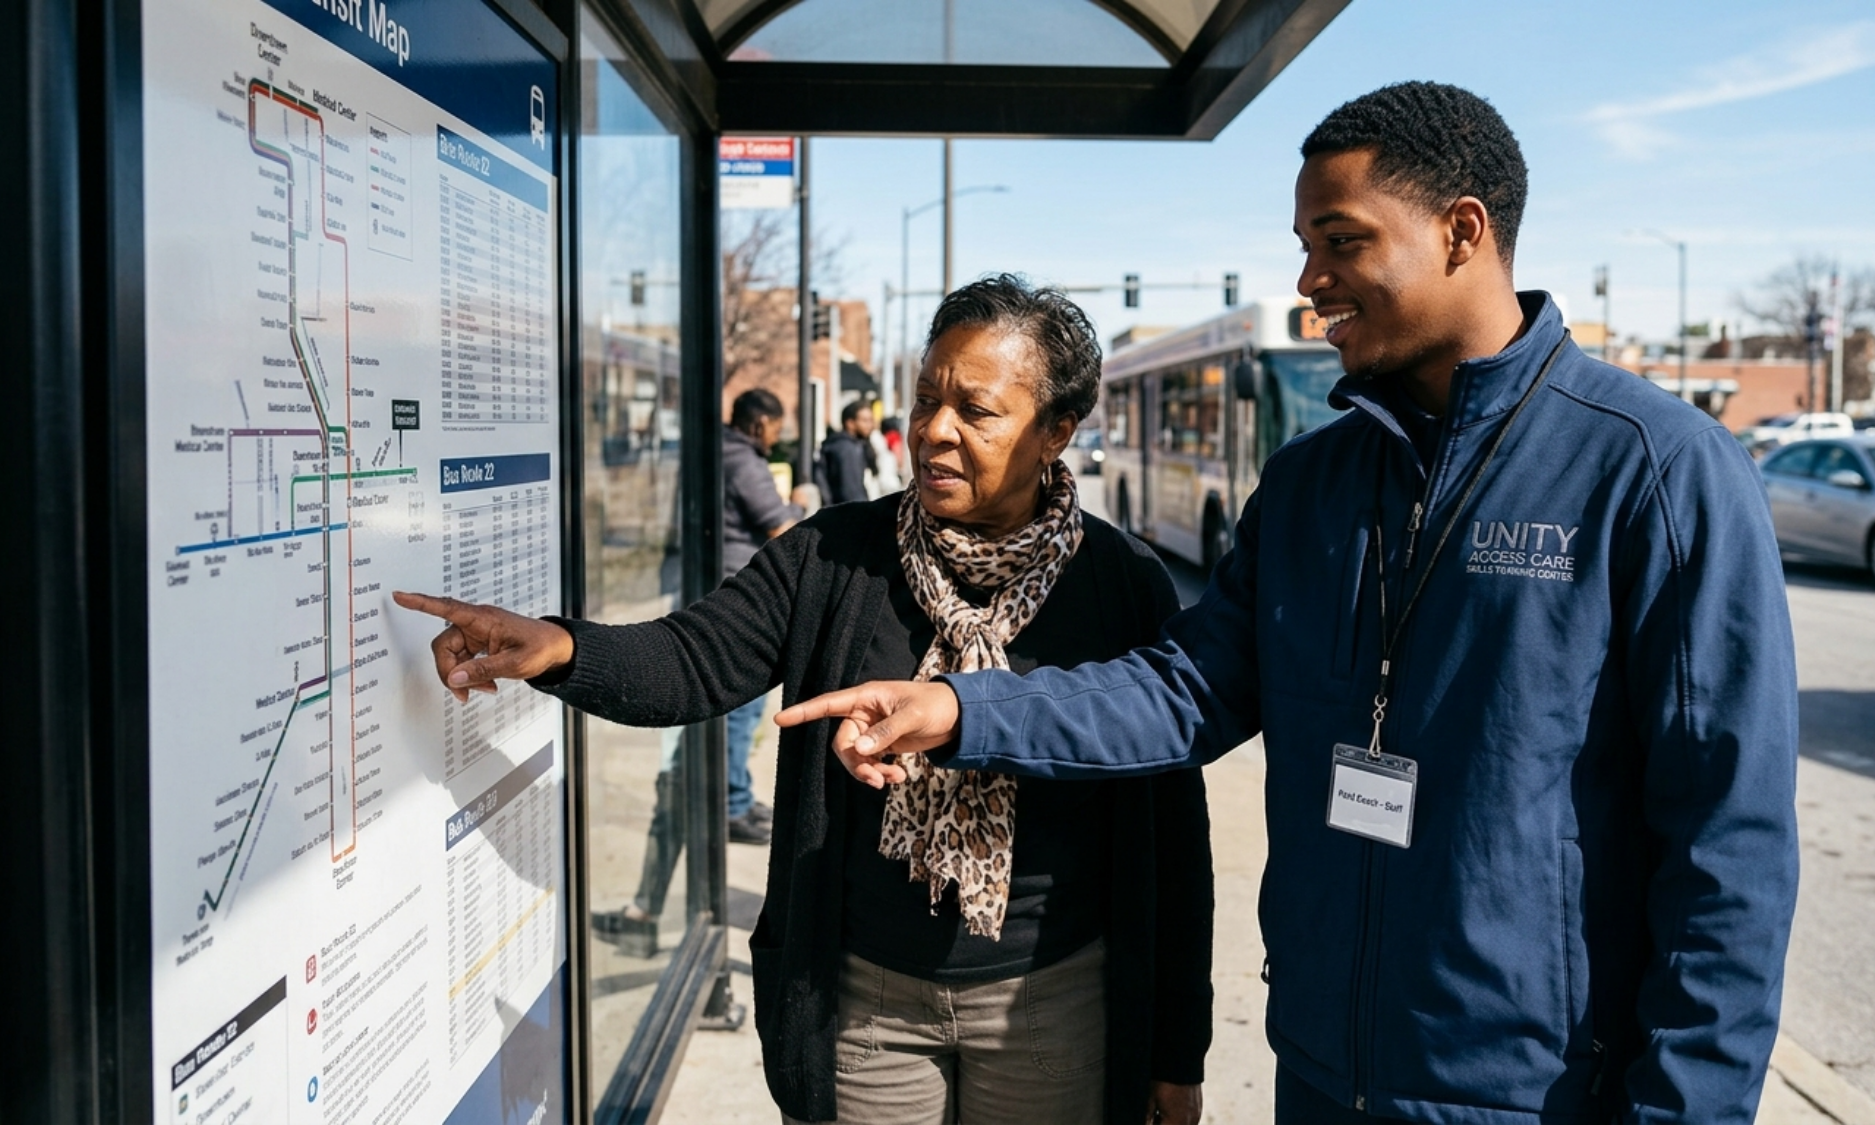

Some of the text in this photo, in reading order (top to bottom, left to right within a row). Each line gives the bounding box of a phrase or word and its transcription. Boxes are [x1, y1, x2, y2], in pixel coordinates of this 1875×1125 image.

[368, 0, 410, 67] Map
[484, 462, 495, 481] 22
[1471, 520, 1580, 553] UNITY
[1468, 550, 1575, 571] ACCESS CARE
